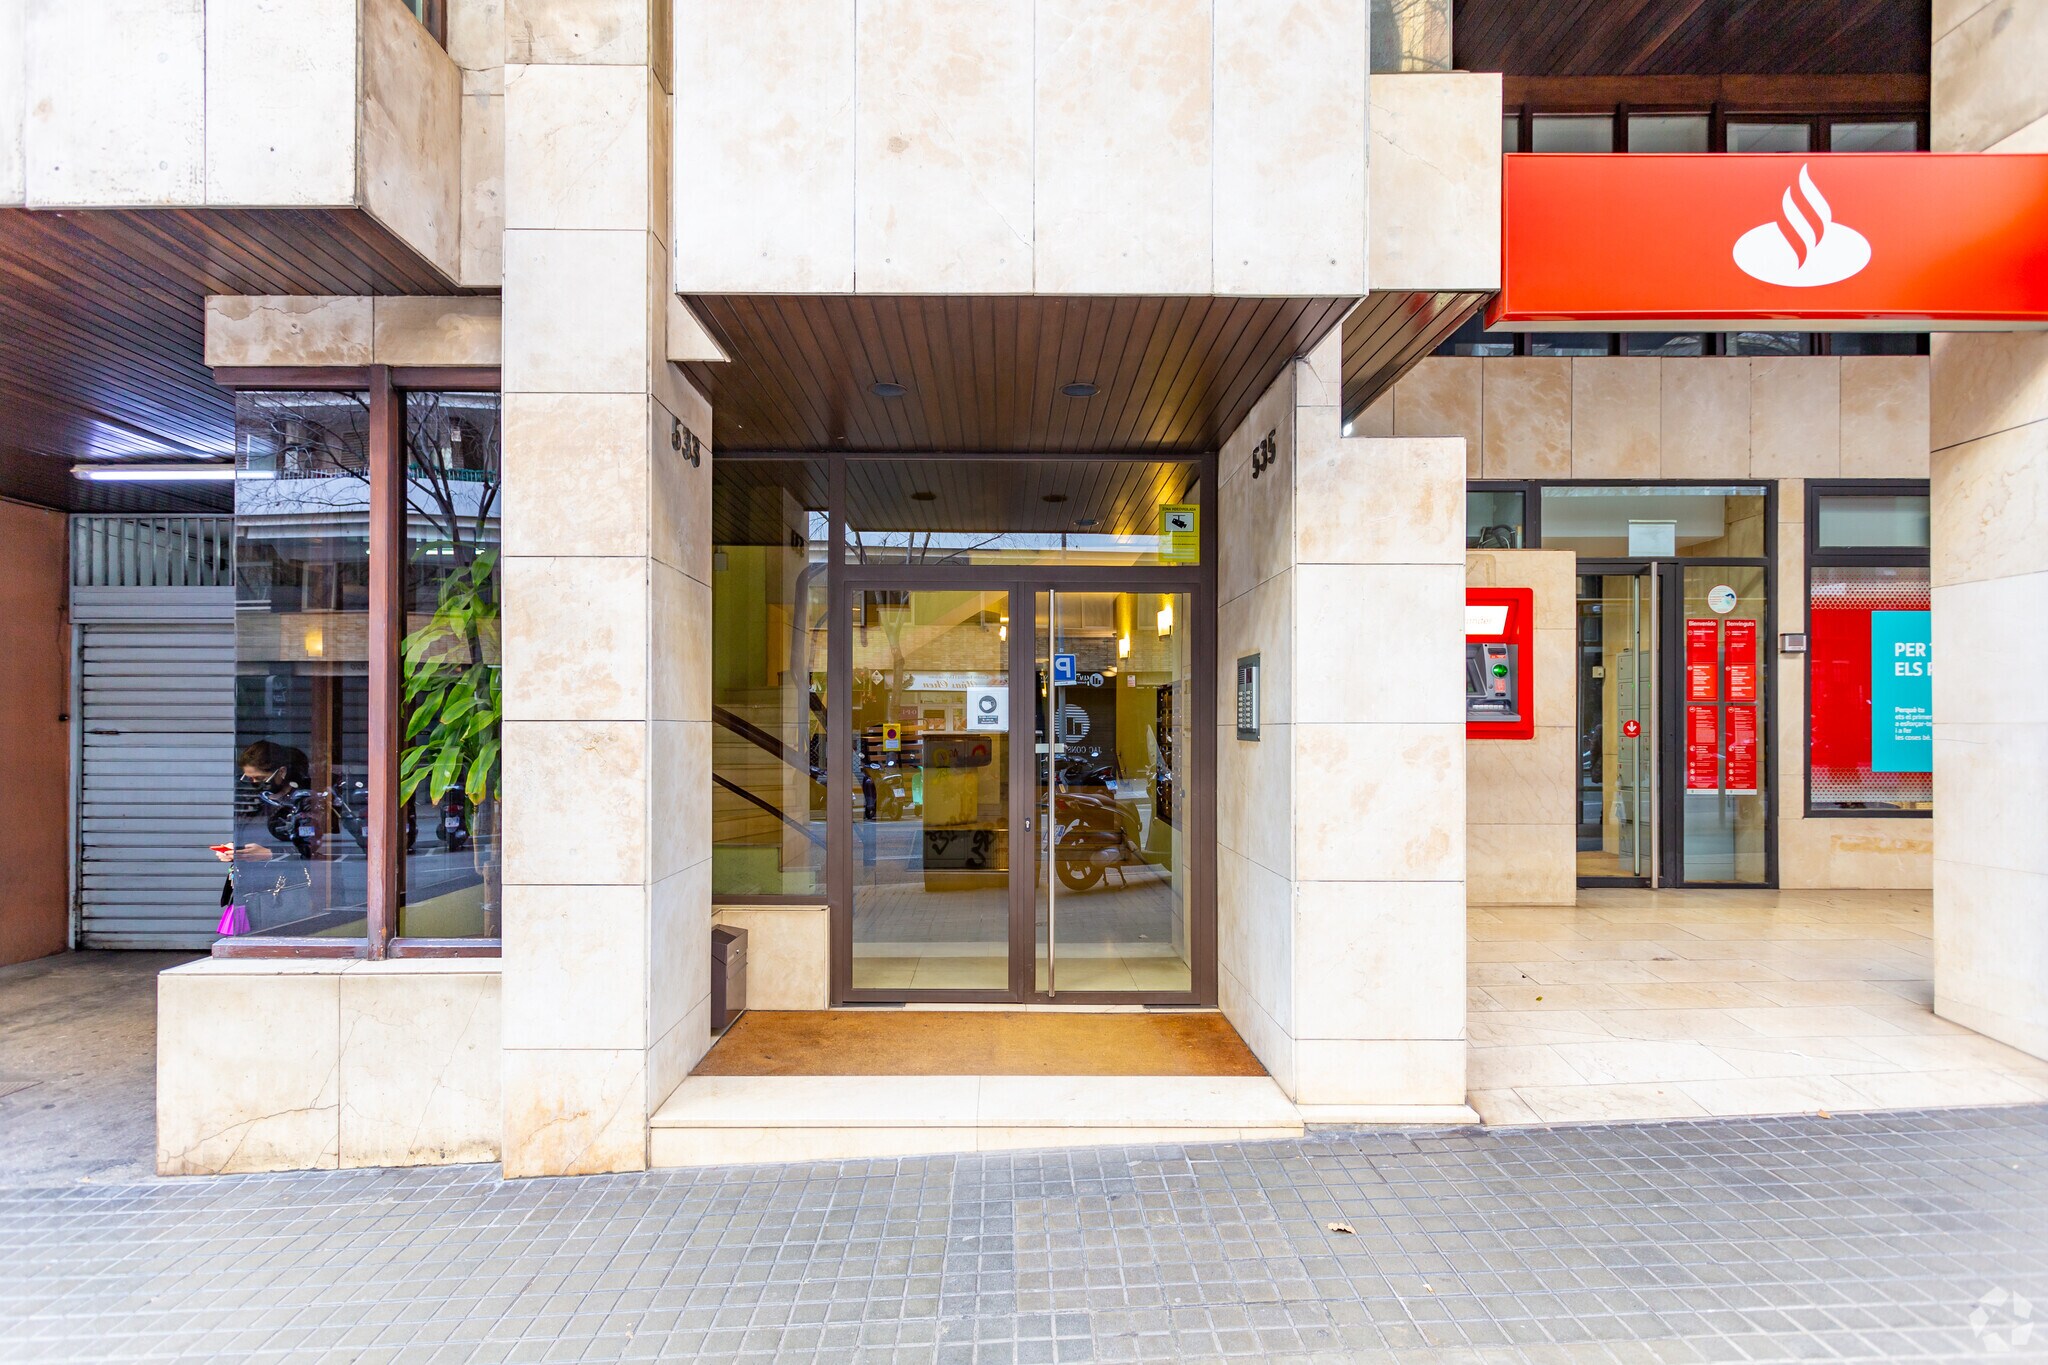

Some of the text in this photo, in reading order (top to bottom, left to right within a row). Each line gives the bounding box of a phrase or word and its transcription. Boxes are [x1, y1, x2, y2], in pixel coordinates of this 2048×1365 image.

[1252, 428, 1277, 480] 535
[1726, 620, 1755, 628] Benvinguts
[1895, 642, 1926, 656] PER
[1895, 662, 1923, 676] ELS
[1895, 706, 1917, 714] Perquè
